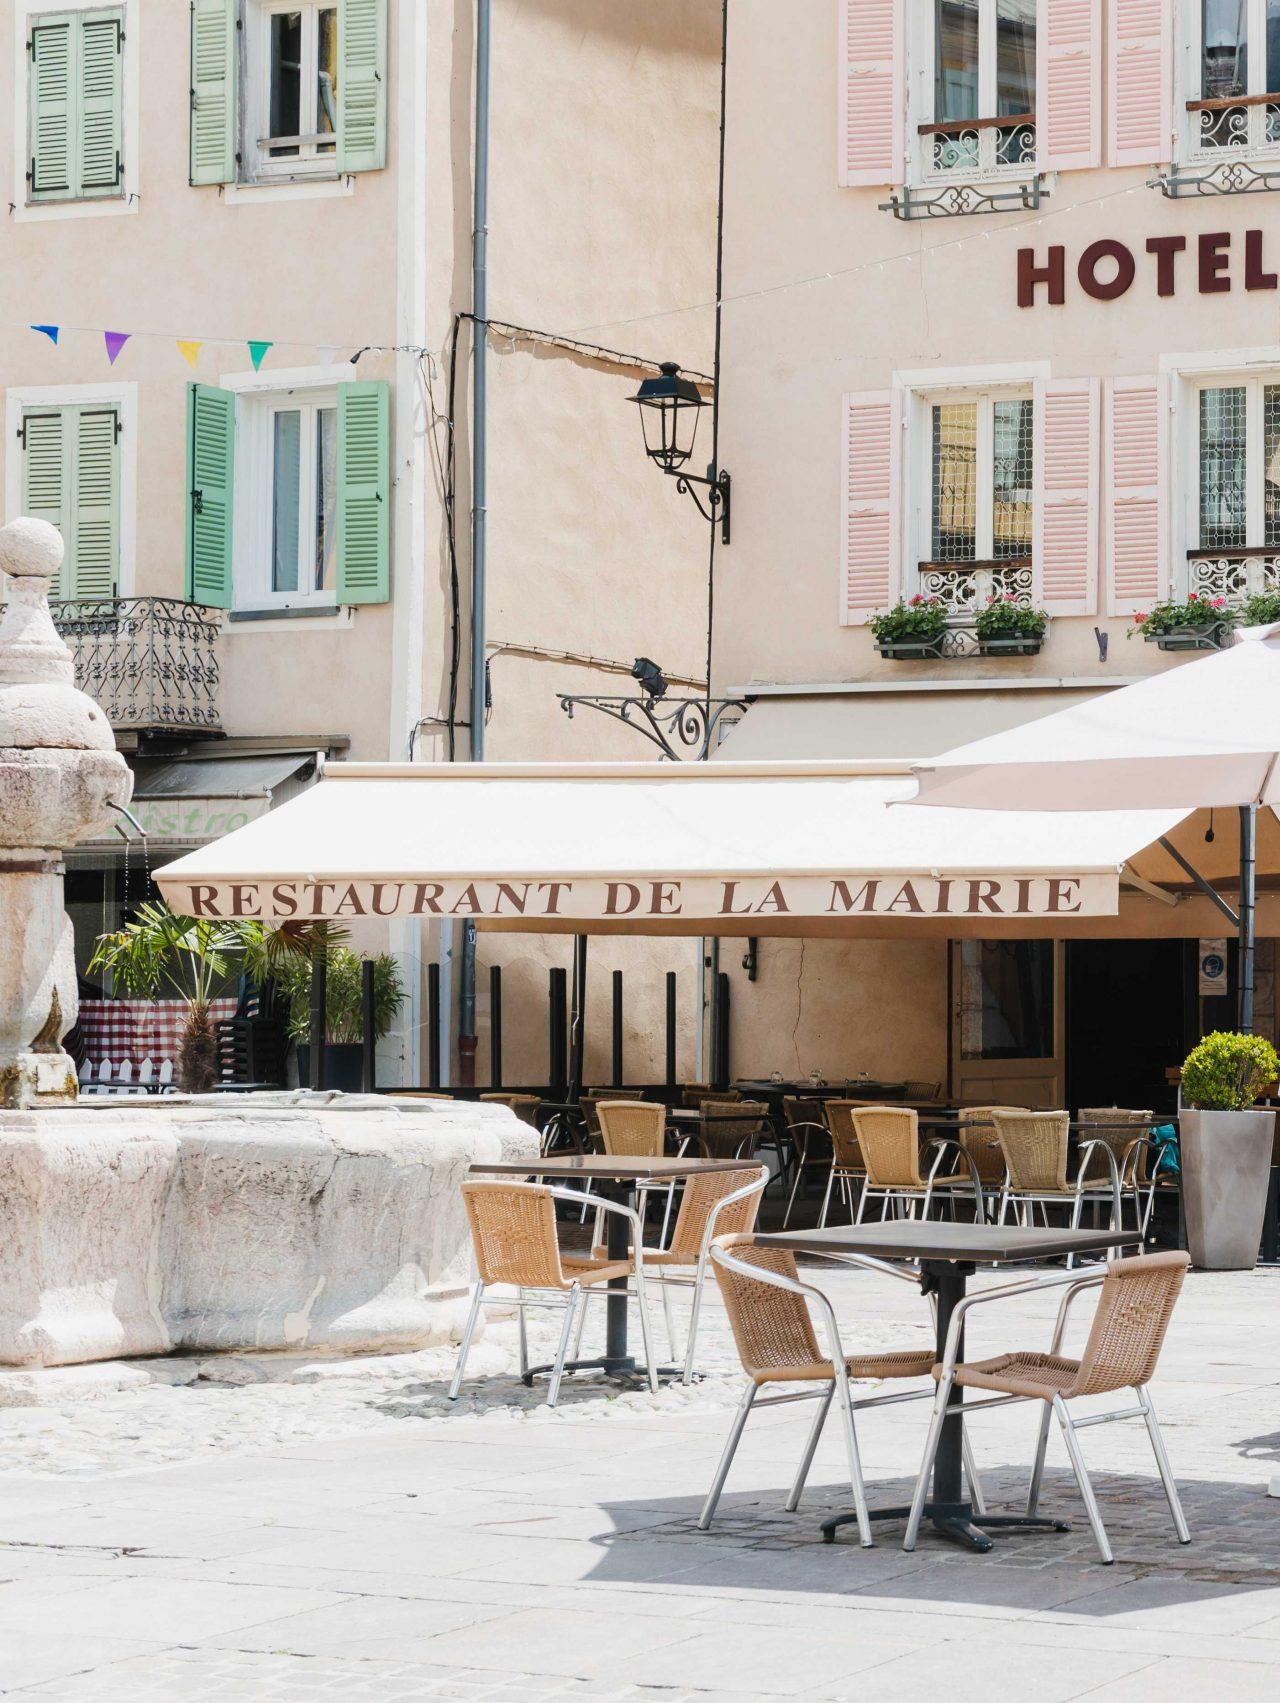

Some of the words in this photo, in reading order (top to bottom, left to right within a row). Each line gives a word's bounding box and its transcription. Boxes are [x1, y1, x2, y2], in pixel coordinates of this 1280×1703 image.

[1016, 229, 1278, 309] HOTEL
[187, 882, 572, 917] RESTAURANT
[602, 881, 682, 915] DE
[718, 880, 790, 914] LA
[826, 878, 1082, 913] MAIRIE
